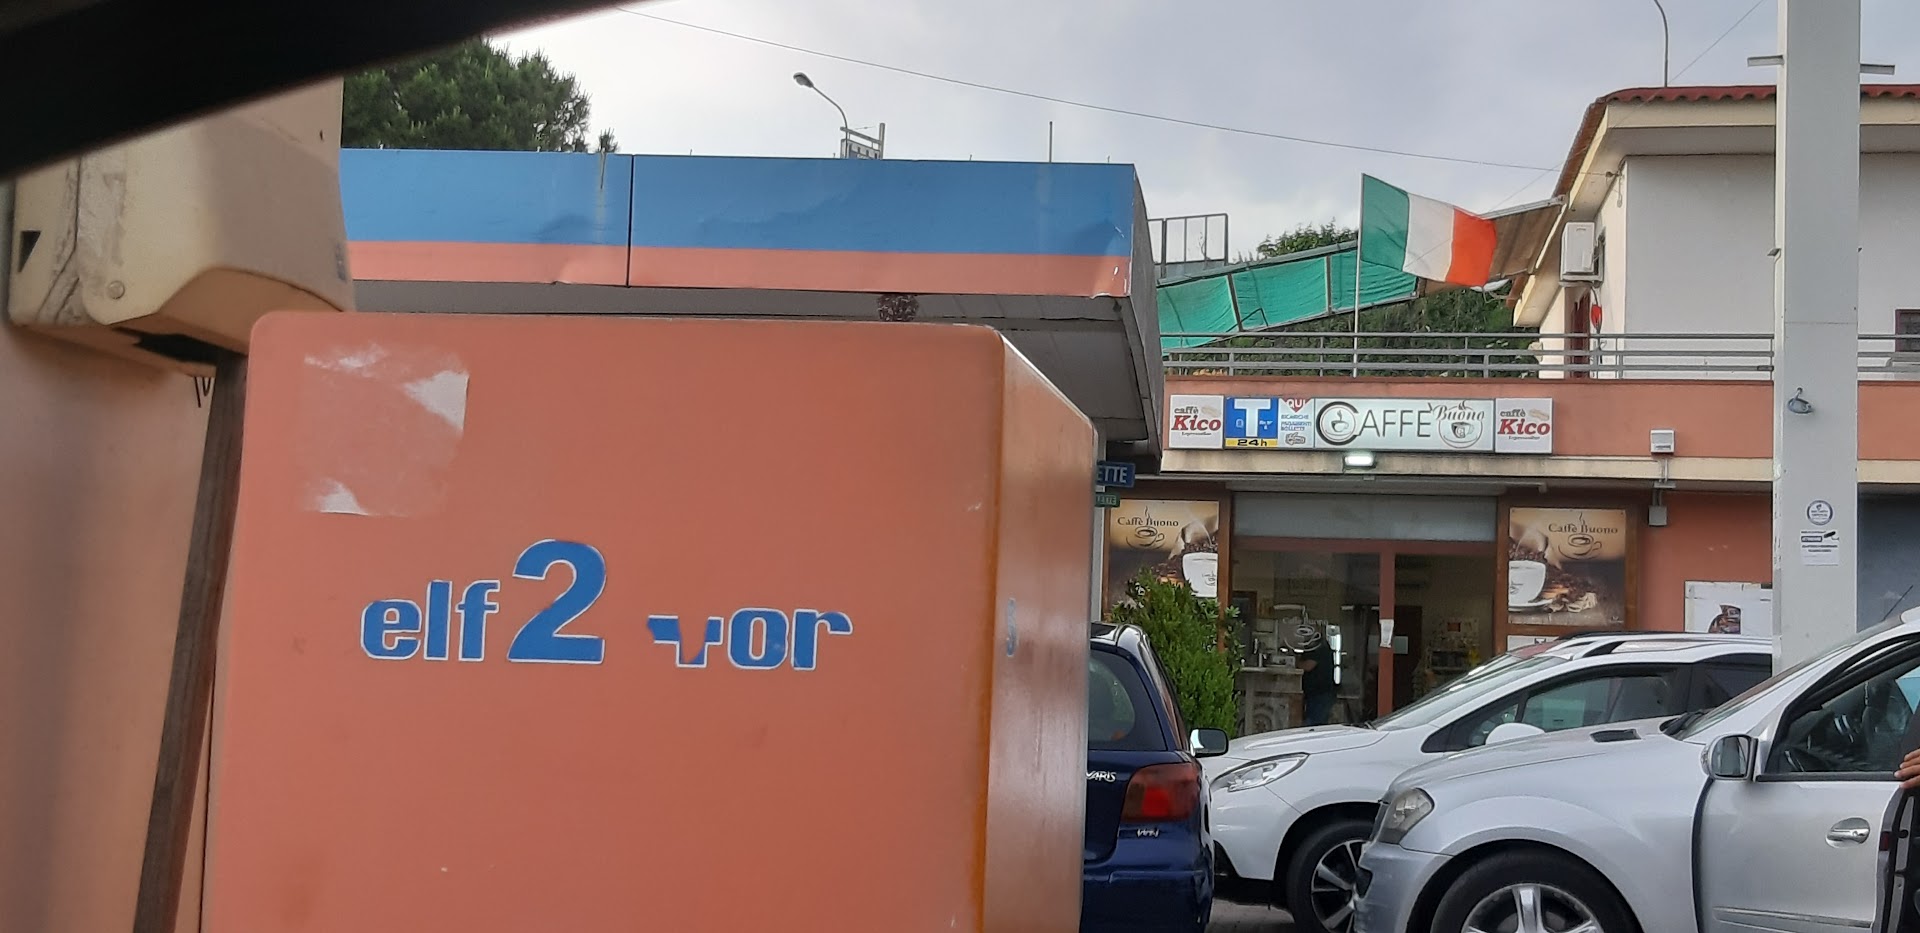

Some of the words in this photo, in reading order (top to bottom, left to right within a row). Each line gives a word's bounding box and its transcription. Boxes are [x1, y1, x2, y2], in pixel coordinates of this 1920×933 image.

[1234, 399, 1270, 437] T
[1435, 404, 1485, 421] Buono
[1171, 415, 1221, 431] Kico
[1497, 418, 1551, 435] Kico
[1237, 439, 1268, 447] 24h
[1581, 524, 1618, 534] Buono
[360, 579, 501, 662] elf
[507, 538, 607, 665] 2
[1086, 770, 1117, 783] YARIS
